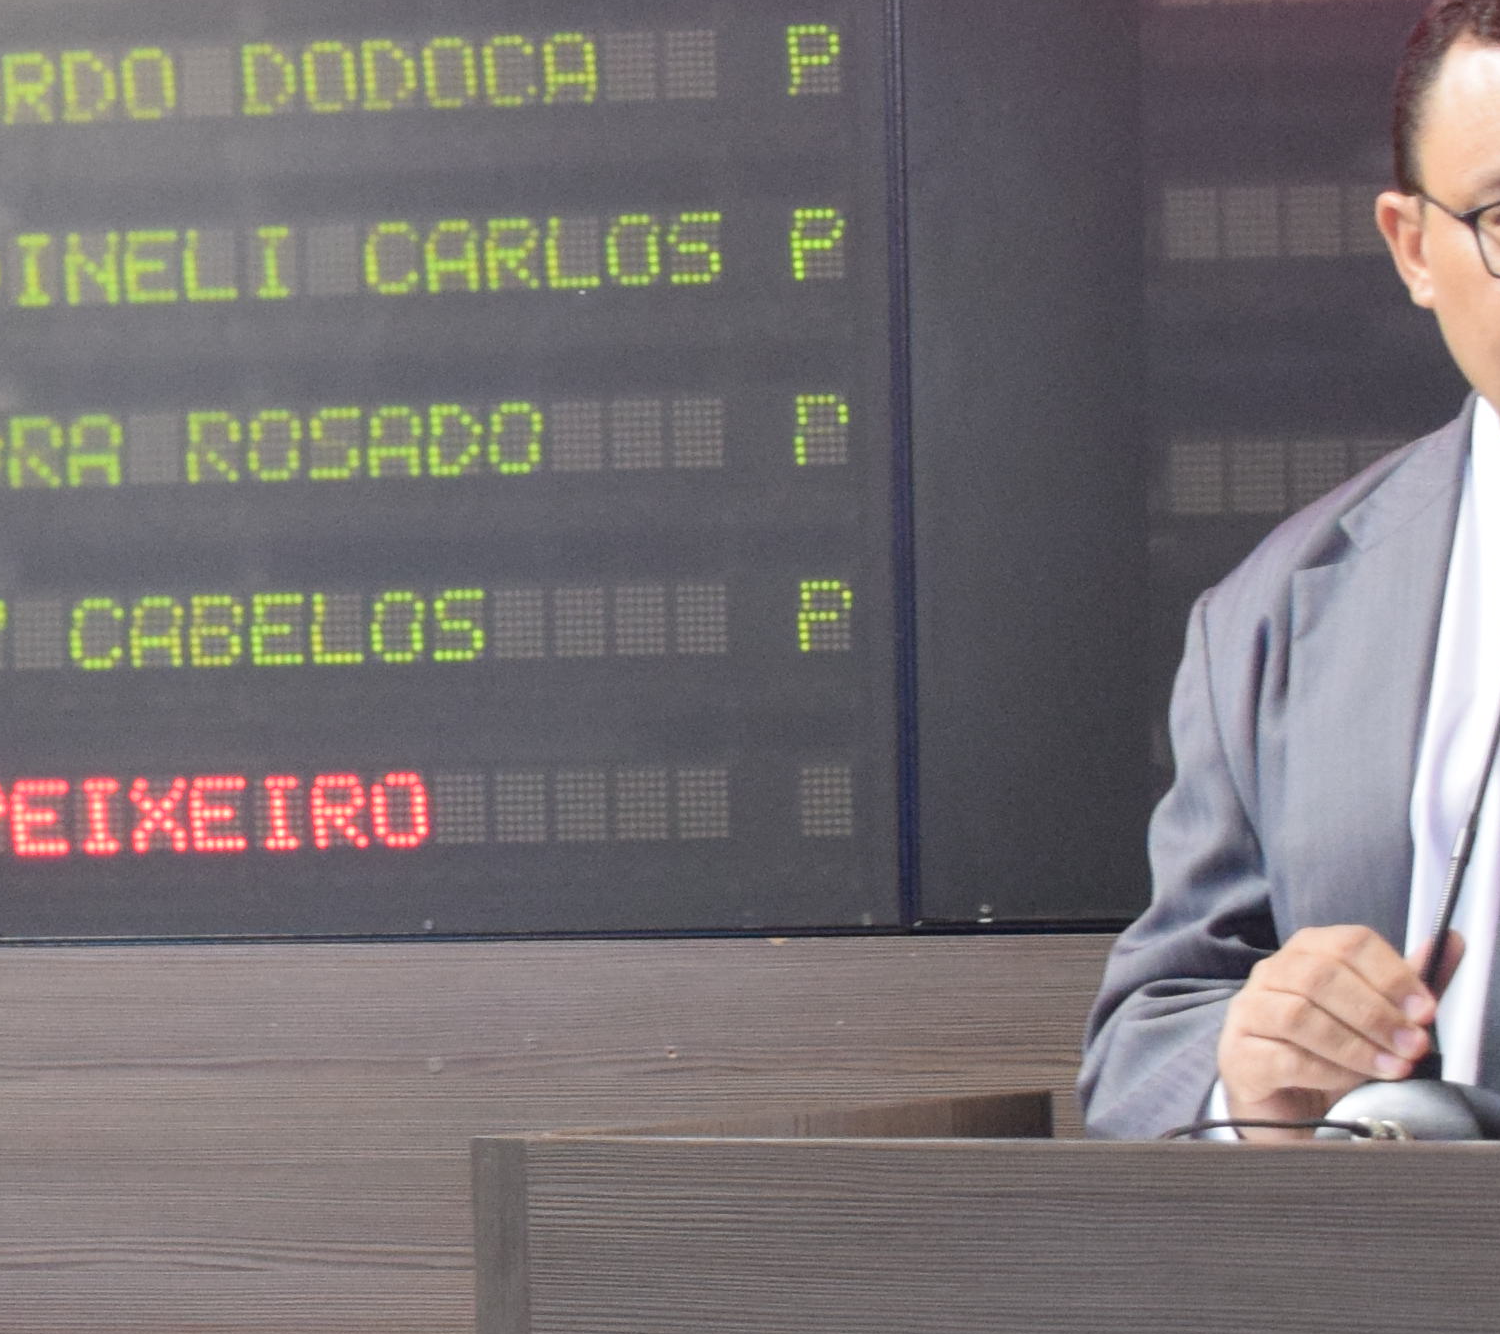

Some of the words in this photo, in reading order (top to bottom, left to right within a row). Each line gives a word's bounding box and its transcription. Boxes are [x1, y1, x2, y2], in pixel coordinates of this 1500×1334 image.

[240, 31, 599, 116] DODOCA
[785, 23, 841, 96] P
[363, 210, 723, 296] CARLOS
[790, 207, 846, 282] P
[185, 401, 545, 484] ROSADO
[67, 588, 486, 671] CABELOS
[798, 578, 854, 653] P
